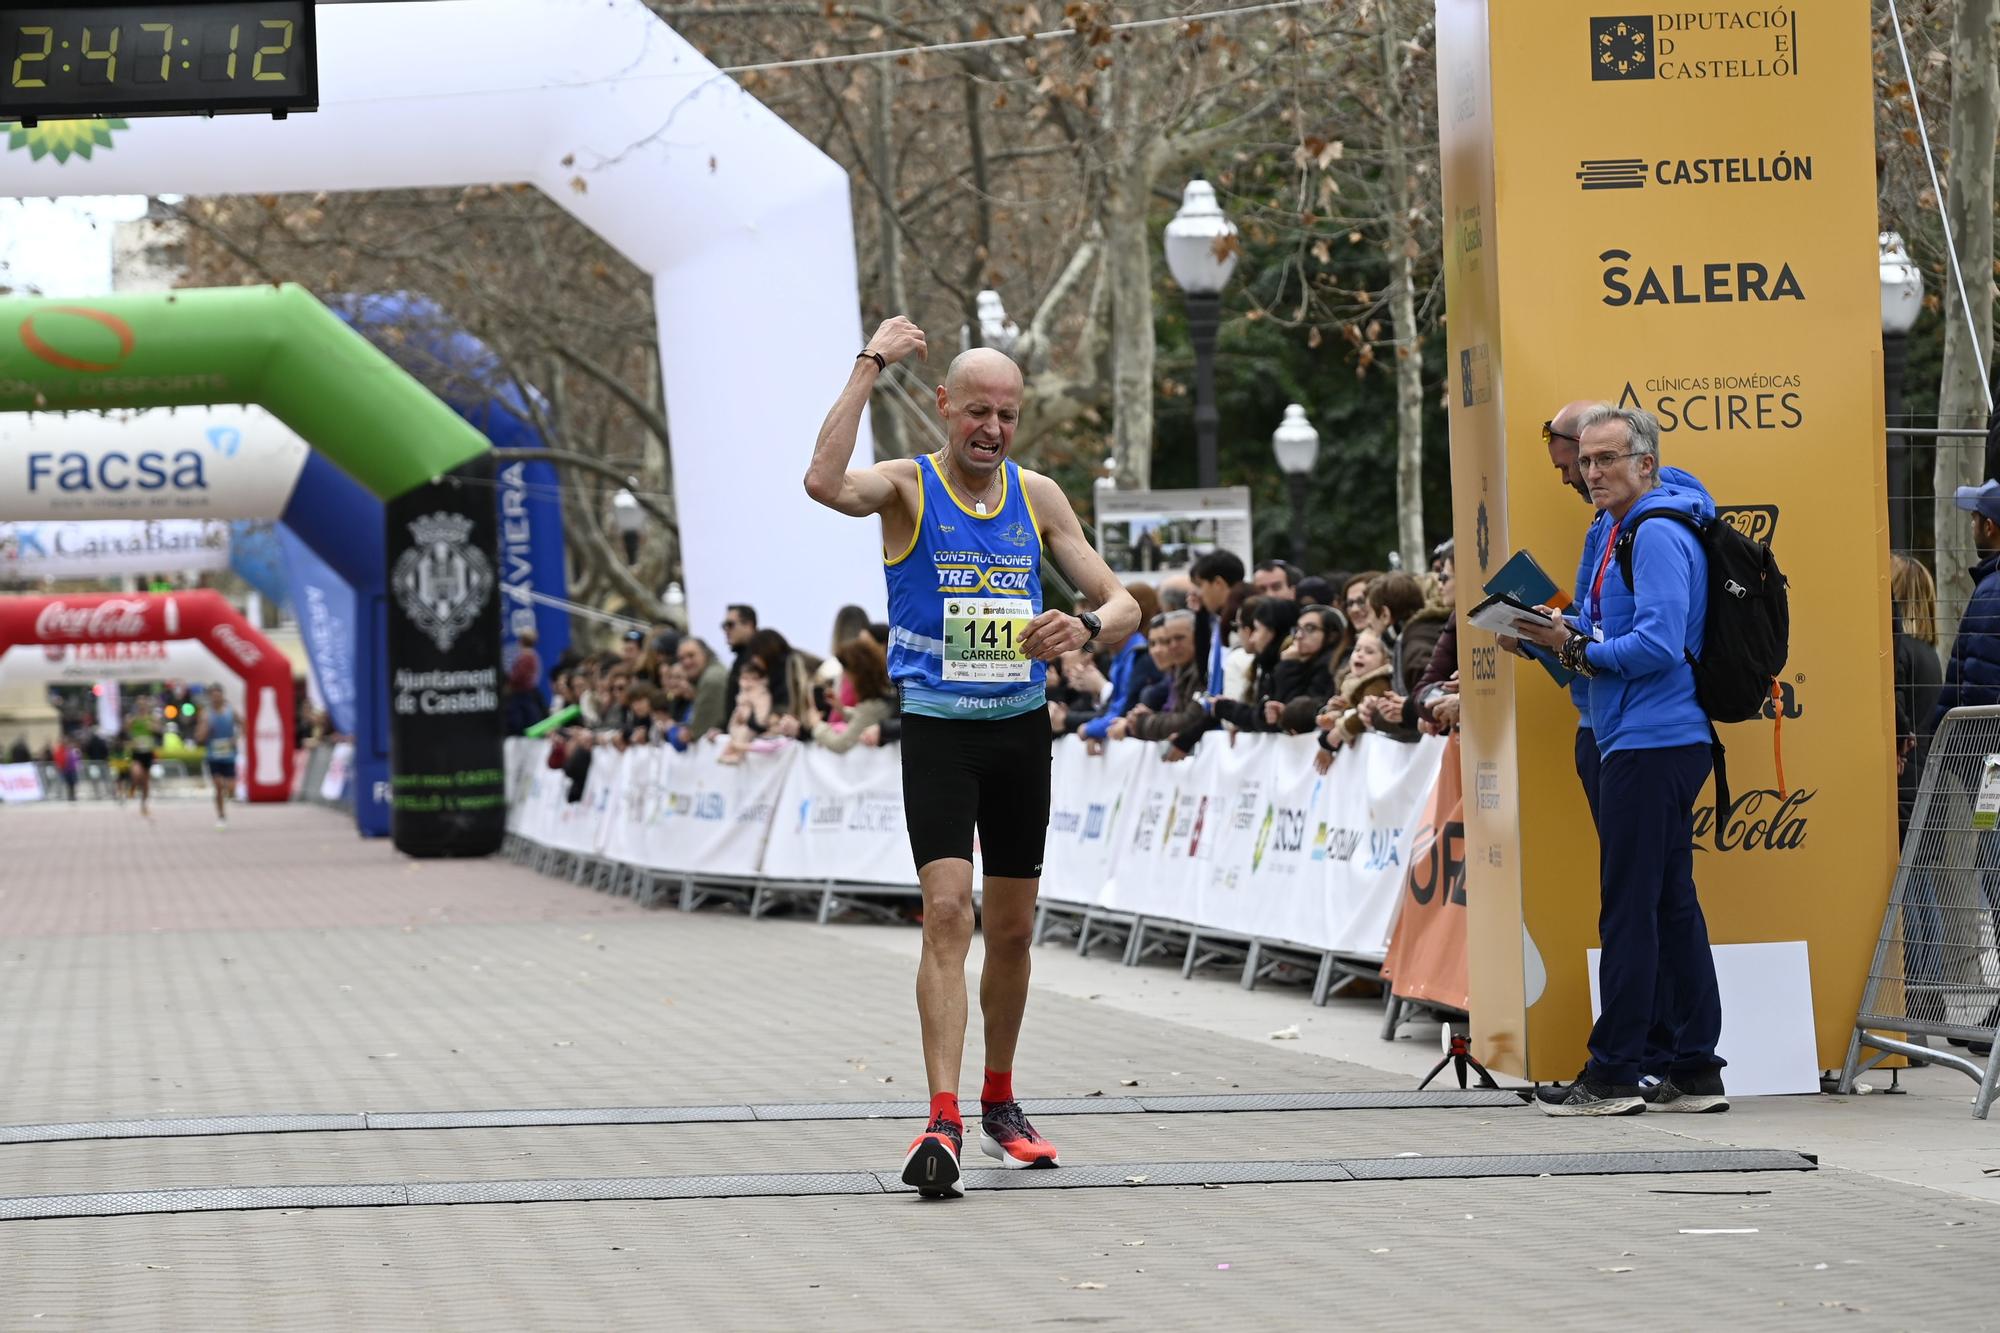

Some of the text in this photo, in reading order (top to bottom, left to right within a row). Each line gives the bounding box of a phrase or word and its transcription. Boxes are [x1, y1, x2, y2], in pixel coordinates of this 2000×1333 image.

[1657, 5, 1787, 31] DIPUTACIÓ
[12, 20, 293, 87] 2:47:12
[1658, 35, 1788, 55] D E
[1659, 54, 1789, 79] CASTELLÓ
[1656, 150, 1812, 185] CASTELLÓN
[1599, 249, 1805, 306] SALERA
[1646, 373, 1801, 391] CLÍNICAS BIOMÉDICAS
[502, 462, 536, 637] BAVIERA
[933, 551, 1032, 566] CONSTRUCCIONES
[35, 600, 151, 640] Coca-Cola
[964, 620, 1012, 649] 141
[961, 650, 1016, 660] CARRERO
